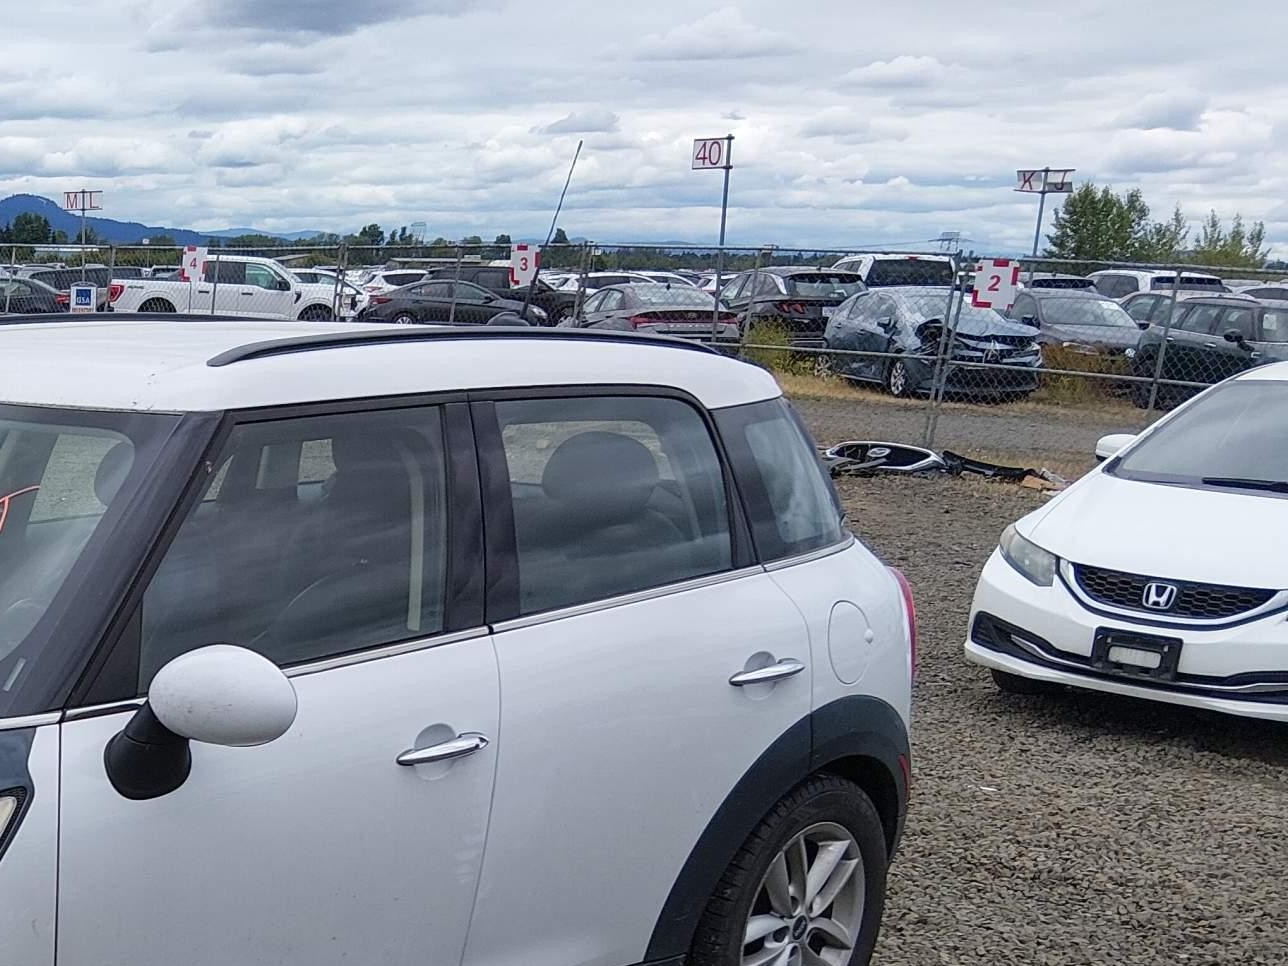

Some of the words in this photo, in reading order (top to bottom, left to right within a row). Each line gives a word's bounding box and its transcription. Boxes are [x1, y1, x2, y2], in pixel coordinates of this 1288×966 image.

[695, 141, 722, 166] 40
[1020, 171, 1036, 190] K
[1054, 170, 1067, 190] J
[66, 192, 78, 208] M
[89, 192, 100, 208] L
[189, 257, 197, 270] 4
[519, 256, 528, 272] 3
[987, 274, 1001, 292] 2
